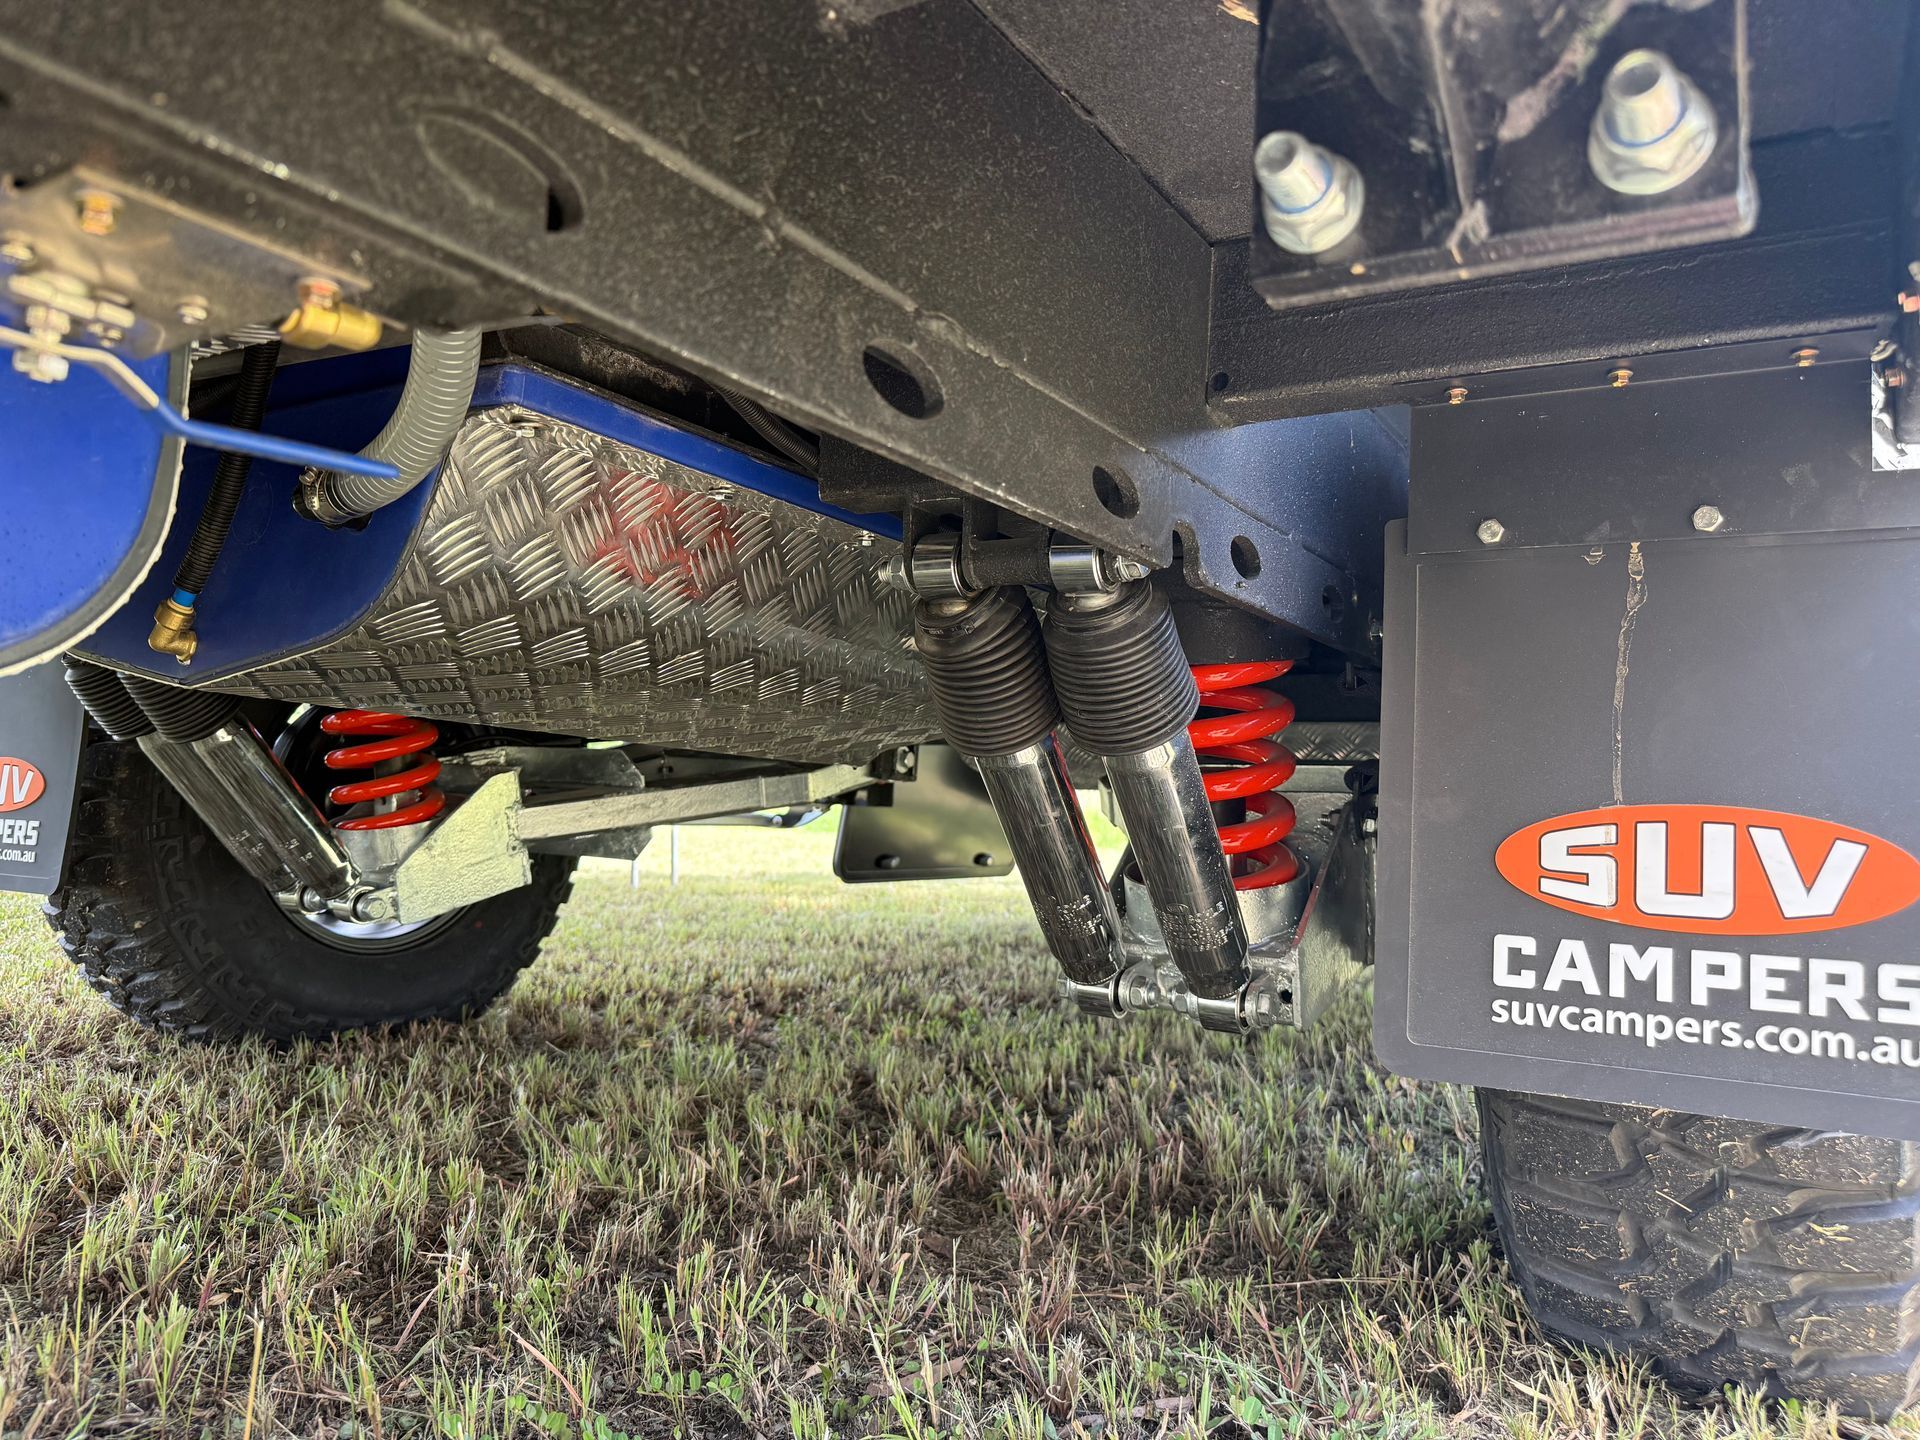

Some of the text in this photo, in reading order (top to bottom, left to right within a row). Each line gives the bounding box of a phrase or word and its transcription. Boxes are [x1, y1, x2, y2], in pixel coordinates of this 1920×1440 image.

[1539, 820, 1869, 919] SUV
[1492, 933, 1920, 1026] CAMPERS
[1491, 998, 1920, 1068] suvcampers.com.au
